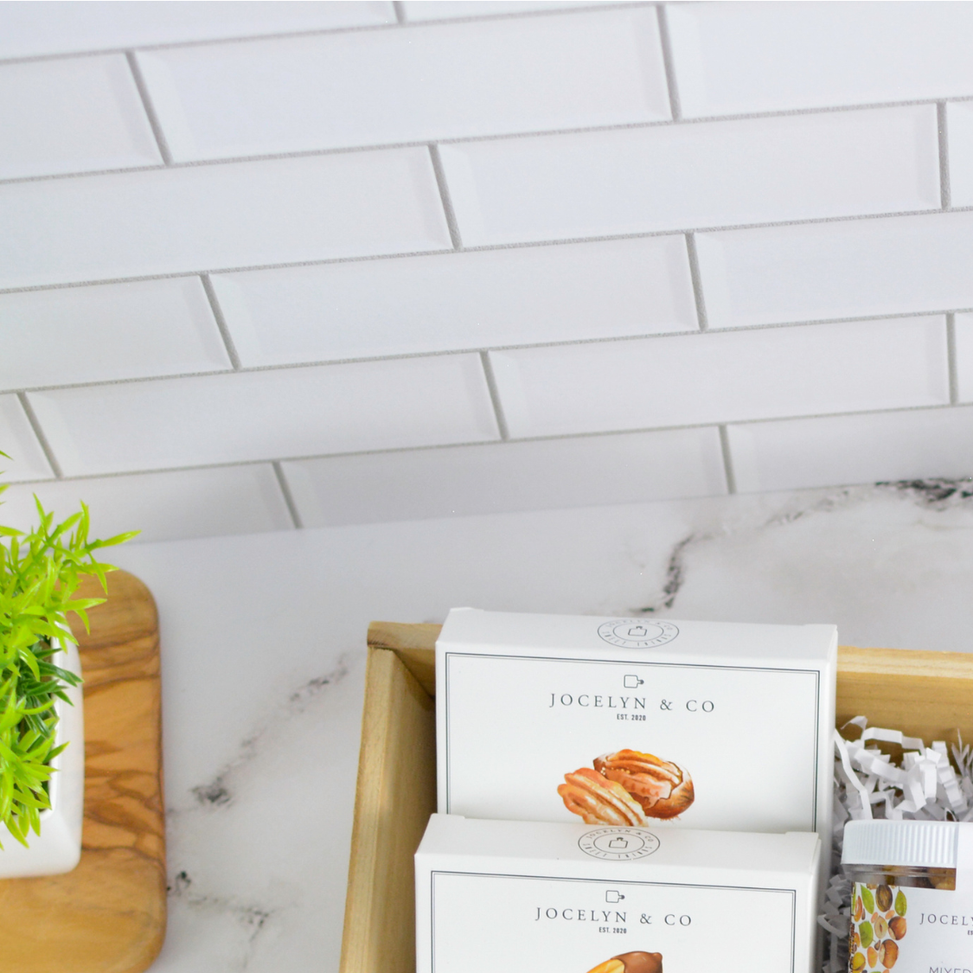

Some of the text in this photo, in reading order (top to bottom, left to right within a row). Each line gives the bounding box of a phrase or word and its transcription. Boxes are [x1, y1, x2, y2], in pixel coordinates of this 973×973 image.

[549, 693, 715, 713] JOCELYN & CO
[535, 907, 692, 926] JOCELYN & CO
